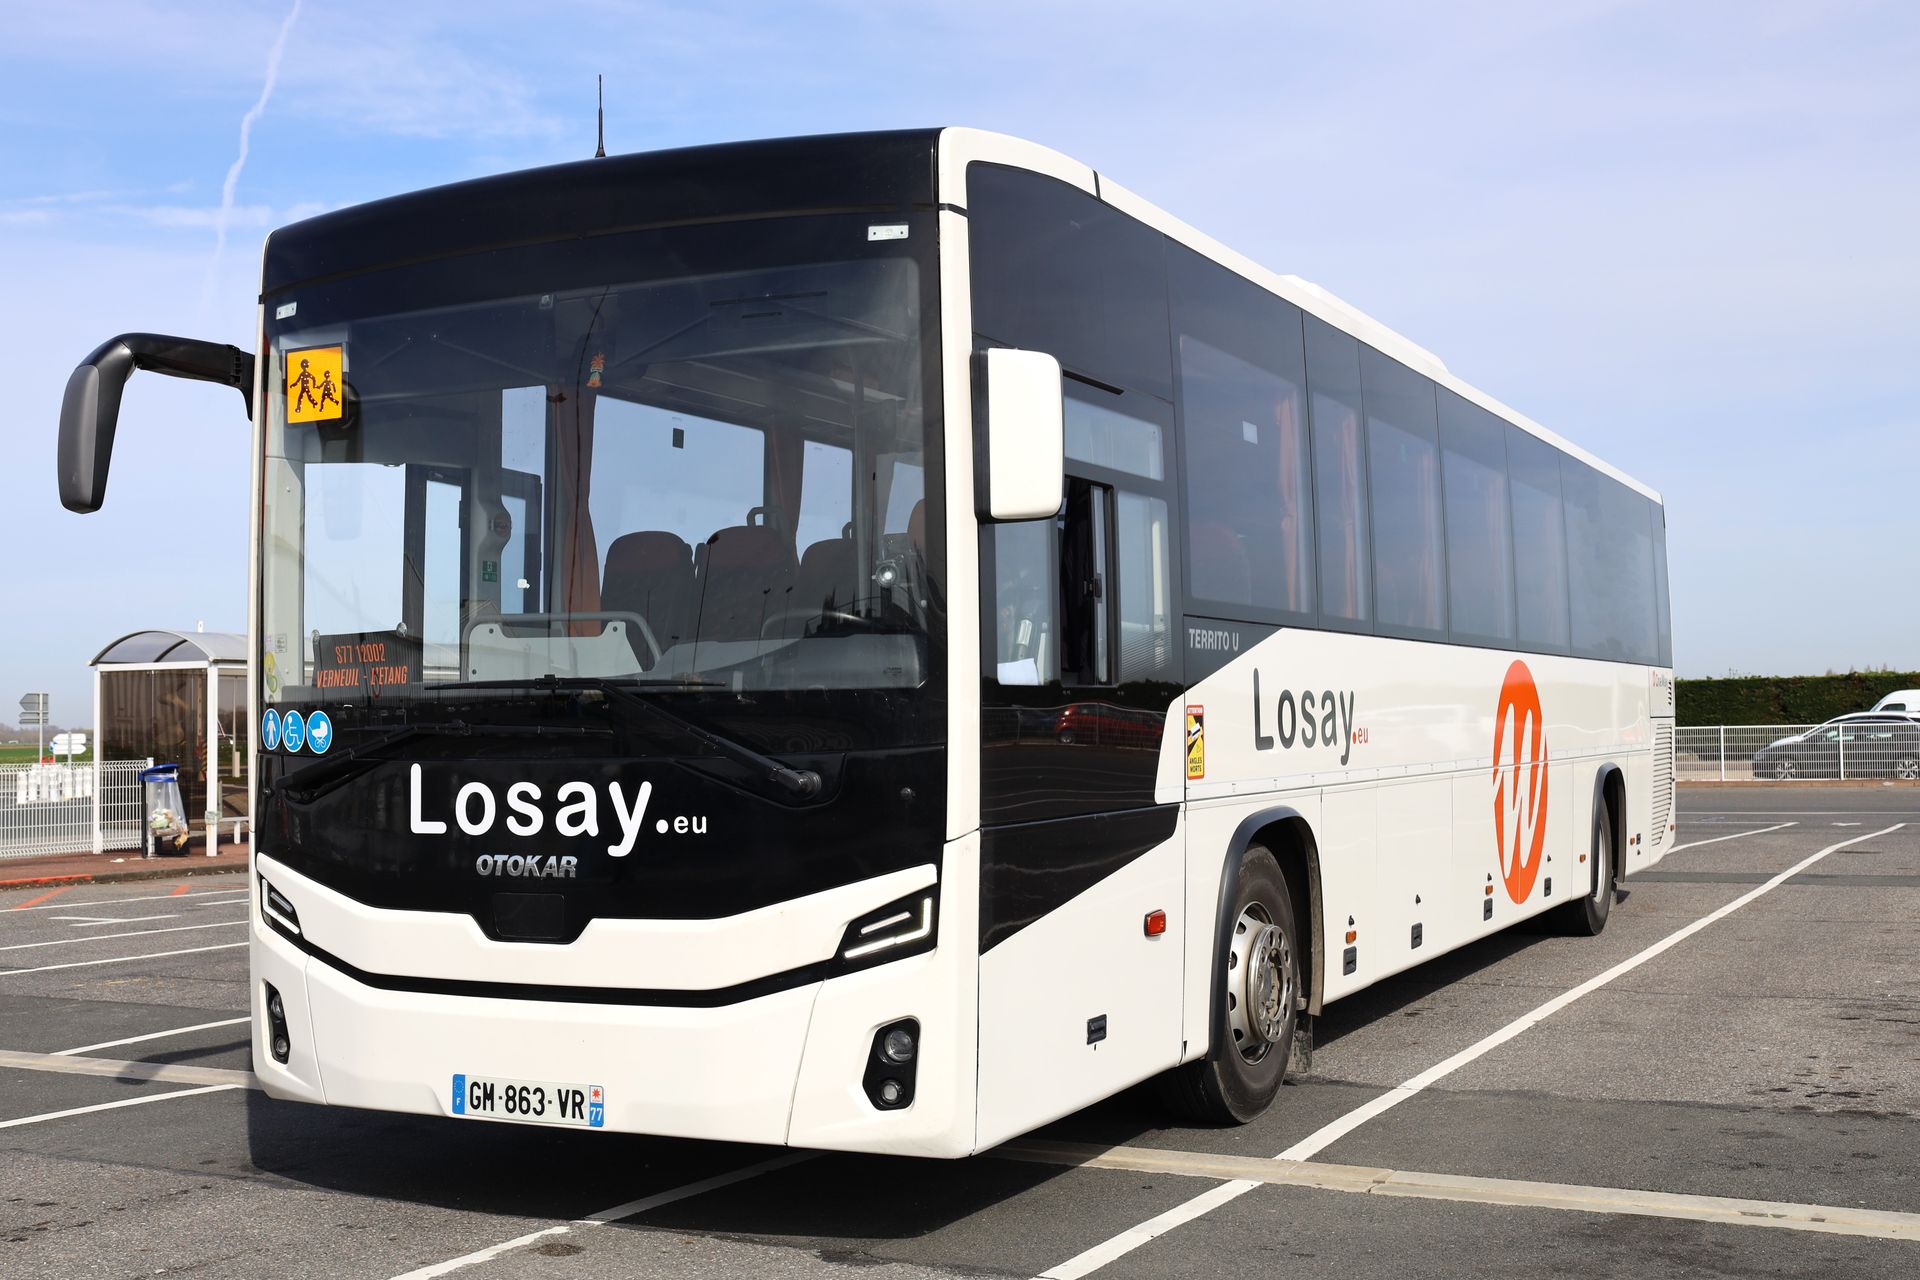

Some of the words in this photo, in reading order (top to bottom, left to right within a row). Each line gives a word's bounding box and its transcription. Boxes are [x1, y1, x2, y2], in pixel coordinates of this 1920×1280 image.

[1189, 628, 1230, 650] TERRITO
[1232, 632, 1239, 651] U
[335, 646, 353, 664] S77
[356, 643, 386, 662] 12002
[316, 668, 360, 688] VERNEUIL
[1253, 667, 1369, 766] Losay.eu
[410, 763, 708, 857] Losay.eu
[475, 854, 578, 878] OTOKAR
[456, 1097, 461, 1106] F
[590, 1107, 603, 1121] 77
